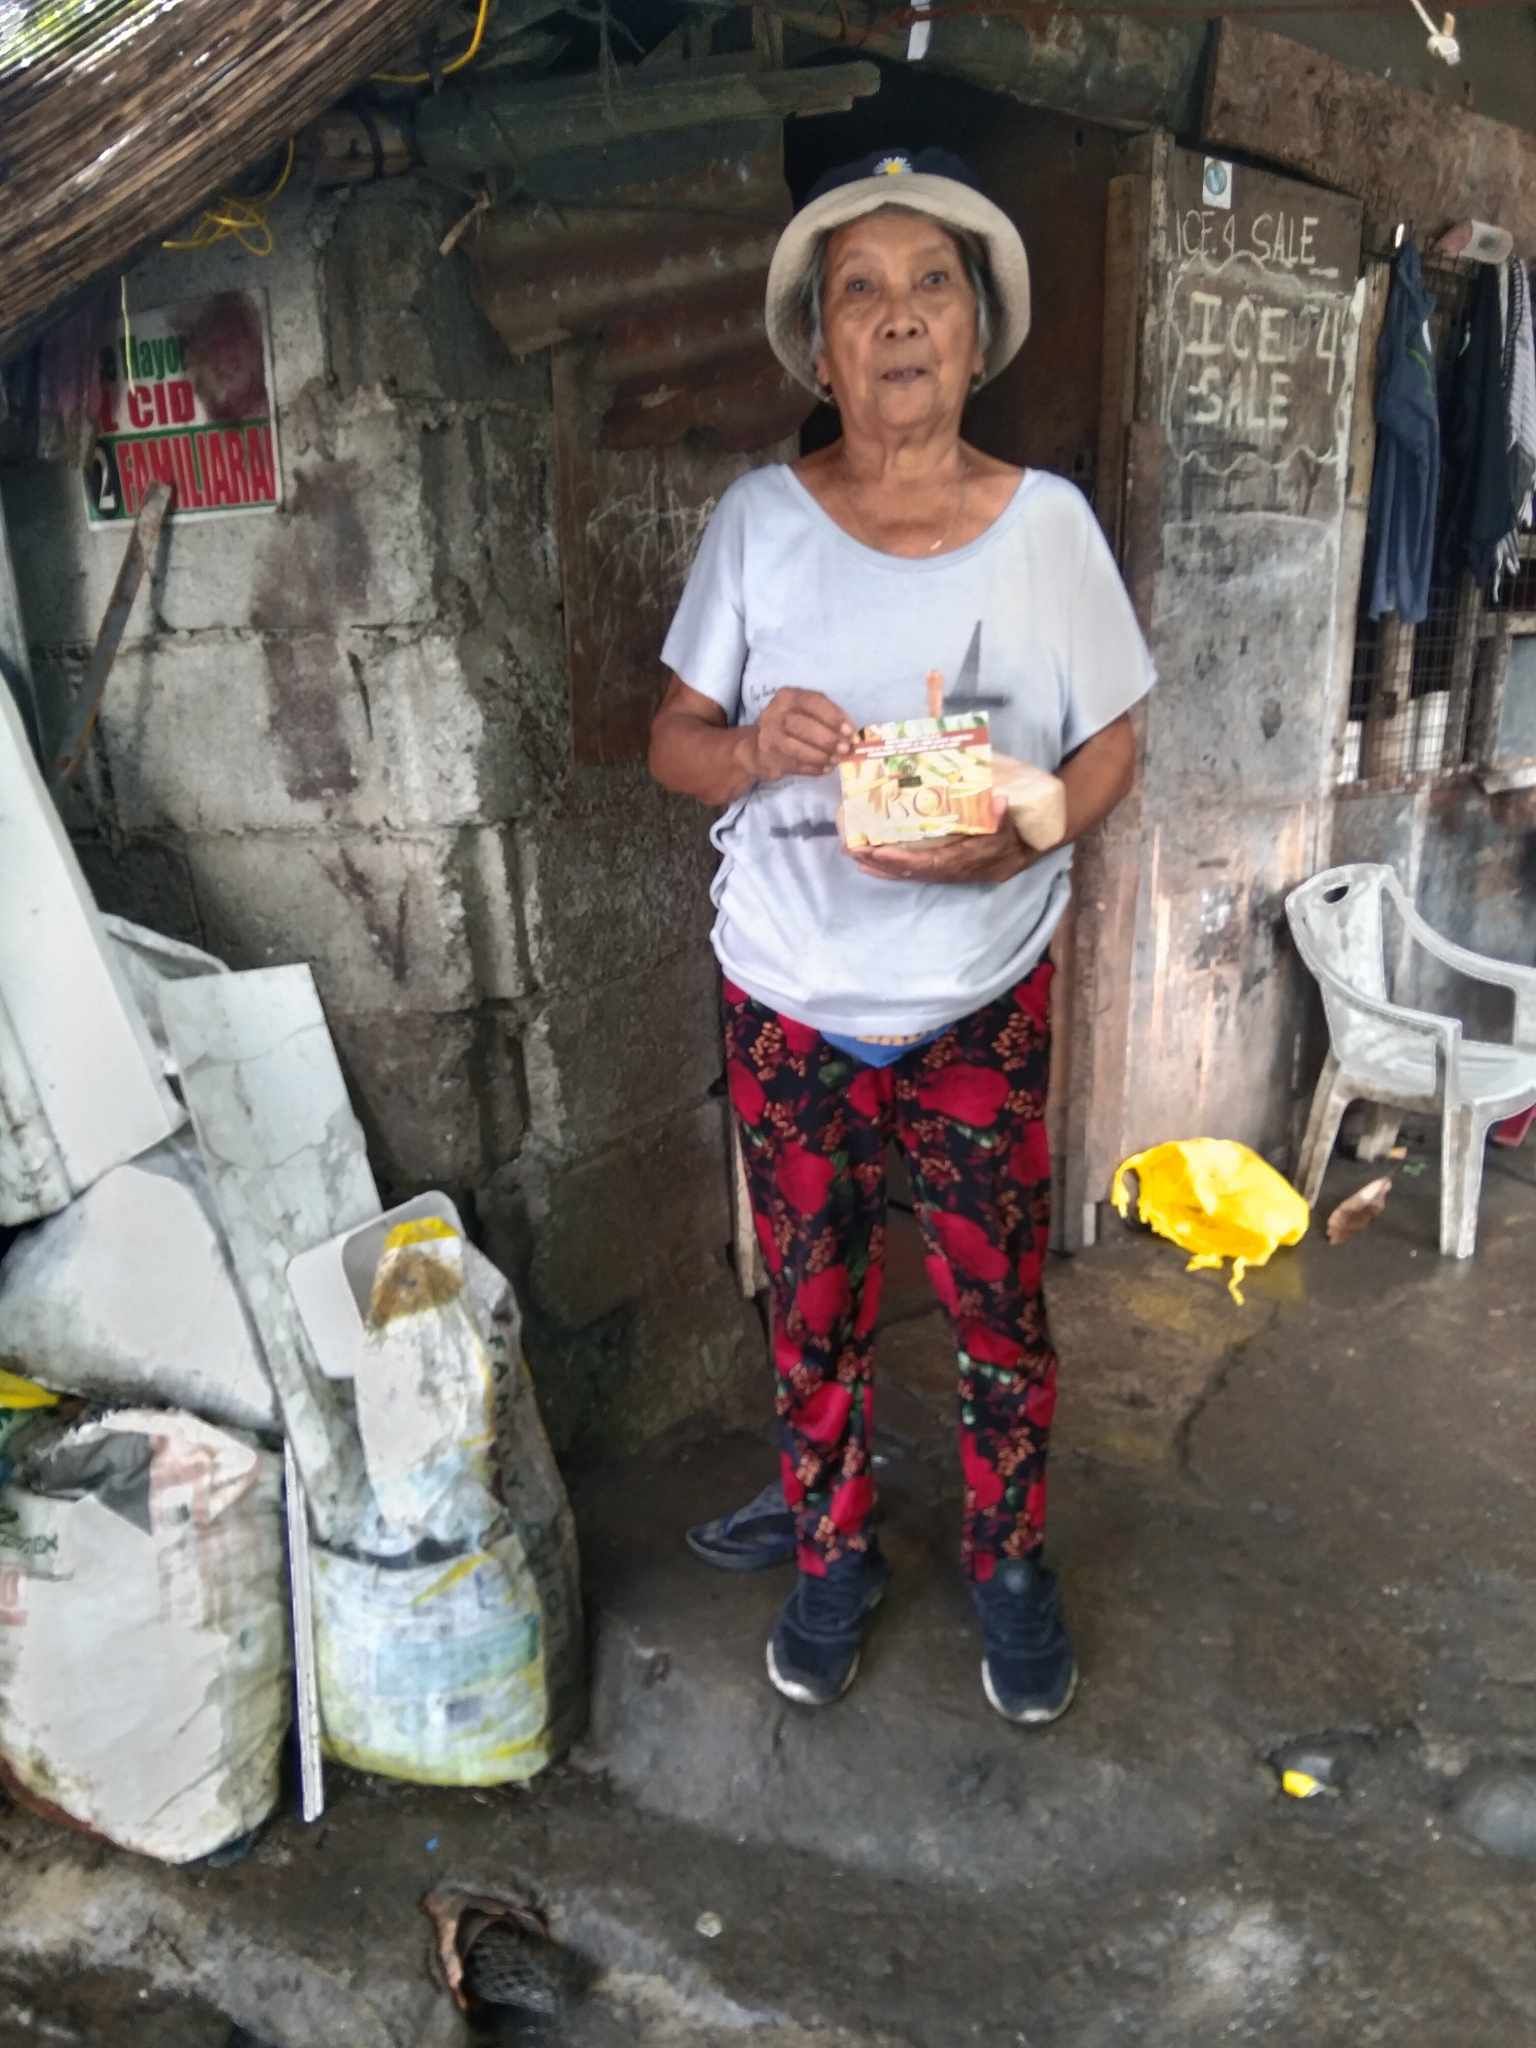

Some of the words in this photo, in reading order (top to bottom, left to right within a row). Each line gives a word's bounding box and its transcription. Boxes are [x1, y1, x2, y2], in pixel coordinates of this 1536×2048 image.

[1250, 211, 1320, 269] SALE
[1184, 291, 1290, 363] ICE
[1315, 306, 1341, 395] 4
[127, 379, 197, 430] CID
[1188, 364, 1293, 430] SALE
